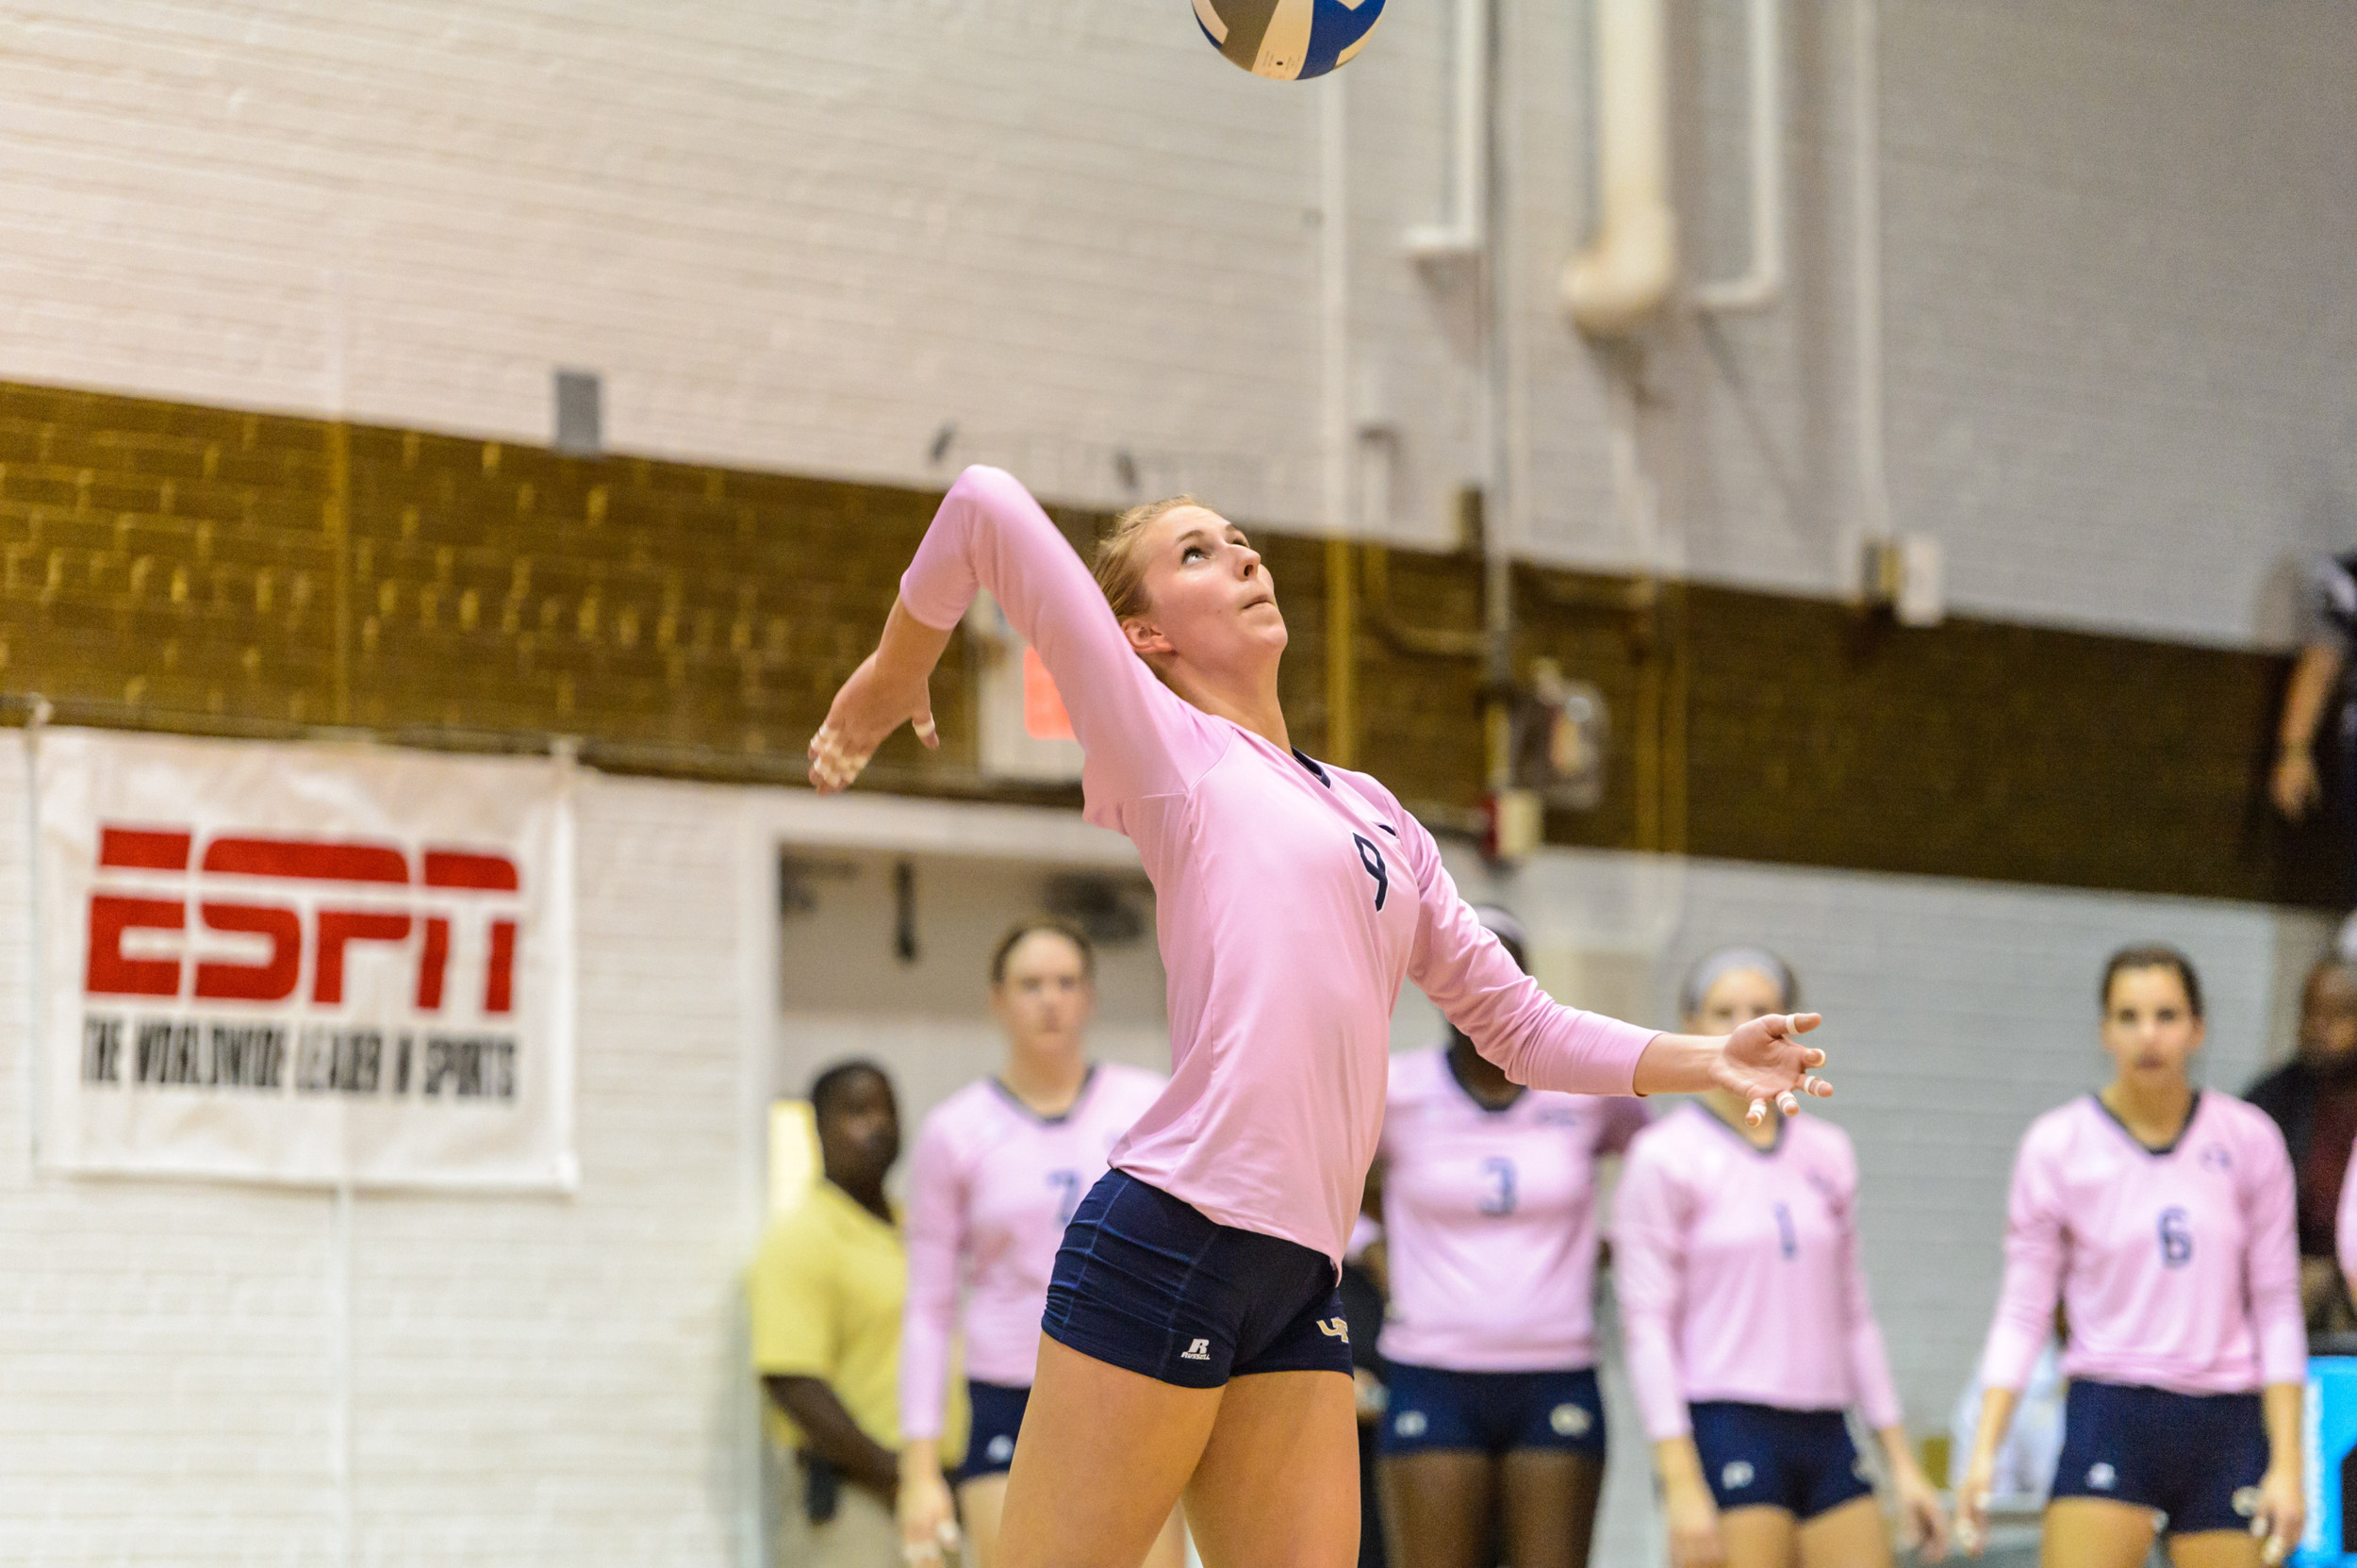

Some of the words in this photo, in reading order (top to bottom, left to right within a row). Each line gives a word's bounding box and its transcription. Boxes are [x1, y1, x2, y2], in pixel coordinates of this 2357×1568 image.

[1352, 832, 1389, 913] 9
[85, 822, 519, 1013] ESPN
[1476, 1156, 1517, 1216] 3
[2158, 1206, 2193, 1267] 6
